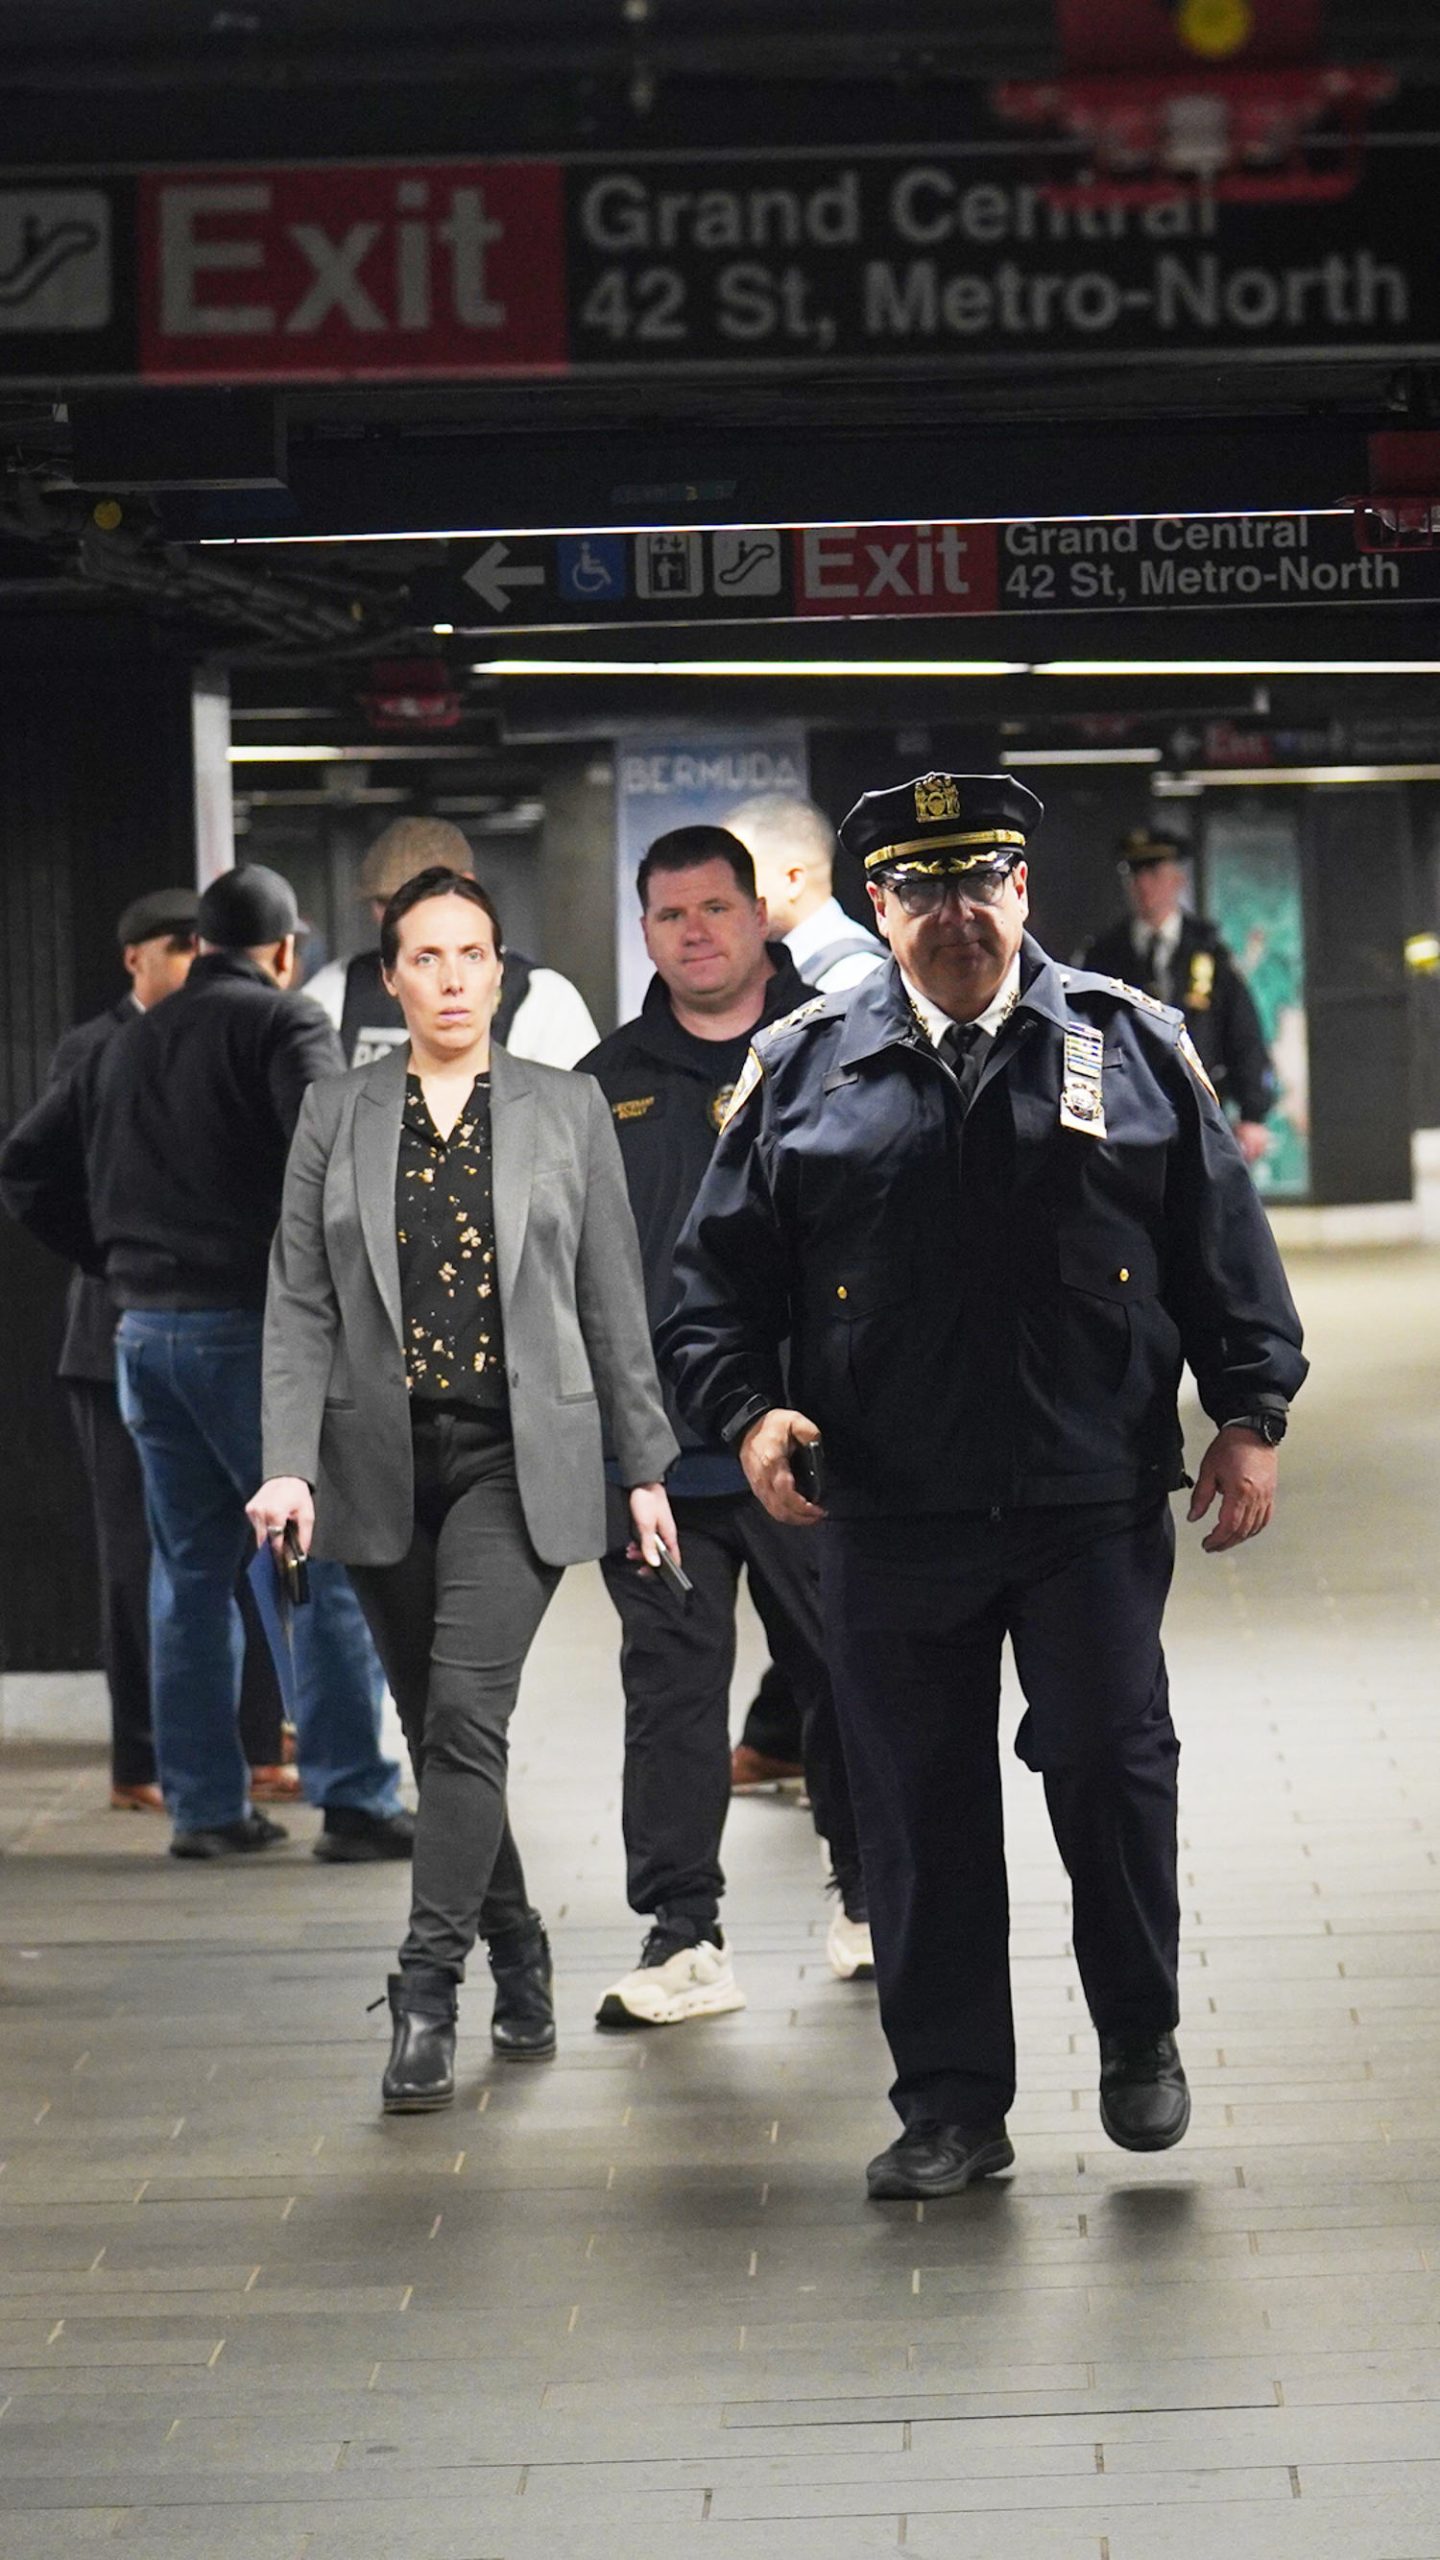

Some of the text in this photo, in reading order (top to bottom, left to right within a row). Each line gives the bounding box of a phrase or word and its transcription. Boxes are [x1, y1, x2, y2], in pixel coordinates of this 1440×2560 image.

[581, 171, 858, 252] Grand
[158, 181, 505, 337] Exit
[581, 250, 1410, 350] 42 St, Metro-North
[803, 525, 970, 598] Exit
[1005, 516, 1308, 556] Grand Central
[1005, 554, 1400, 603] 42 St, Metro-North
[623, 752, 800, 795] BERMUDA
